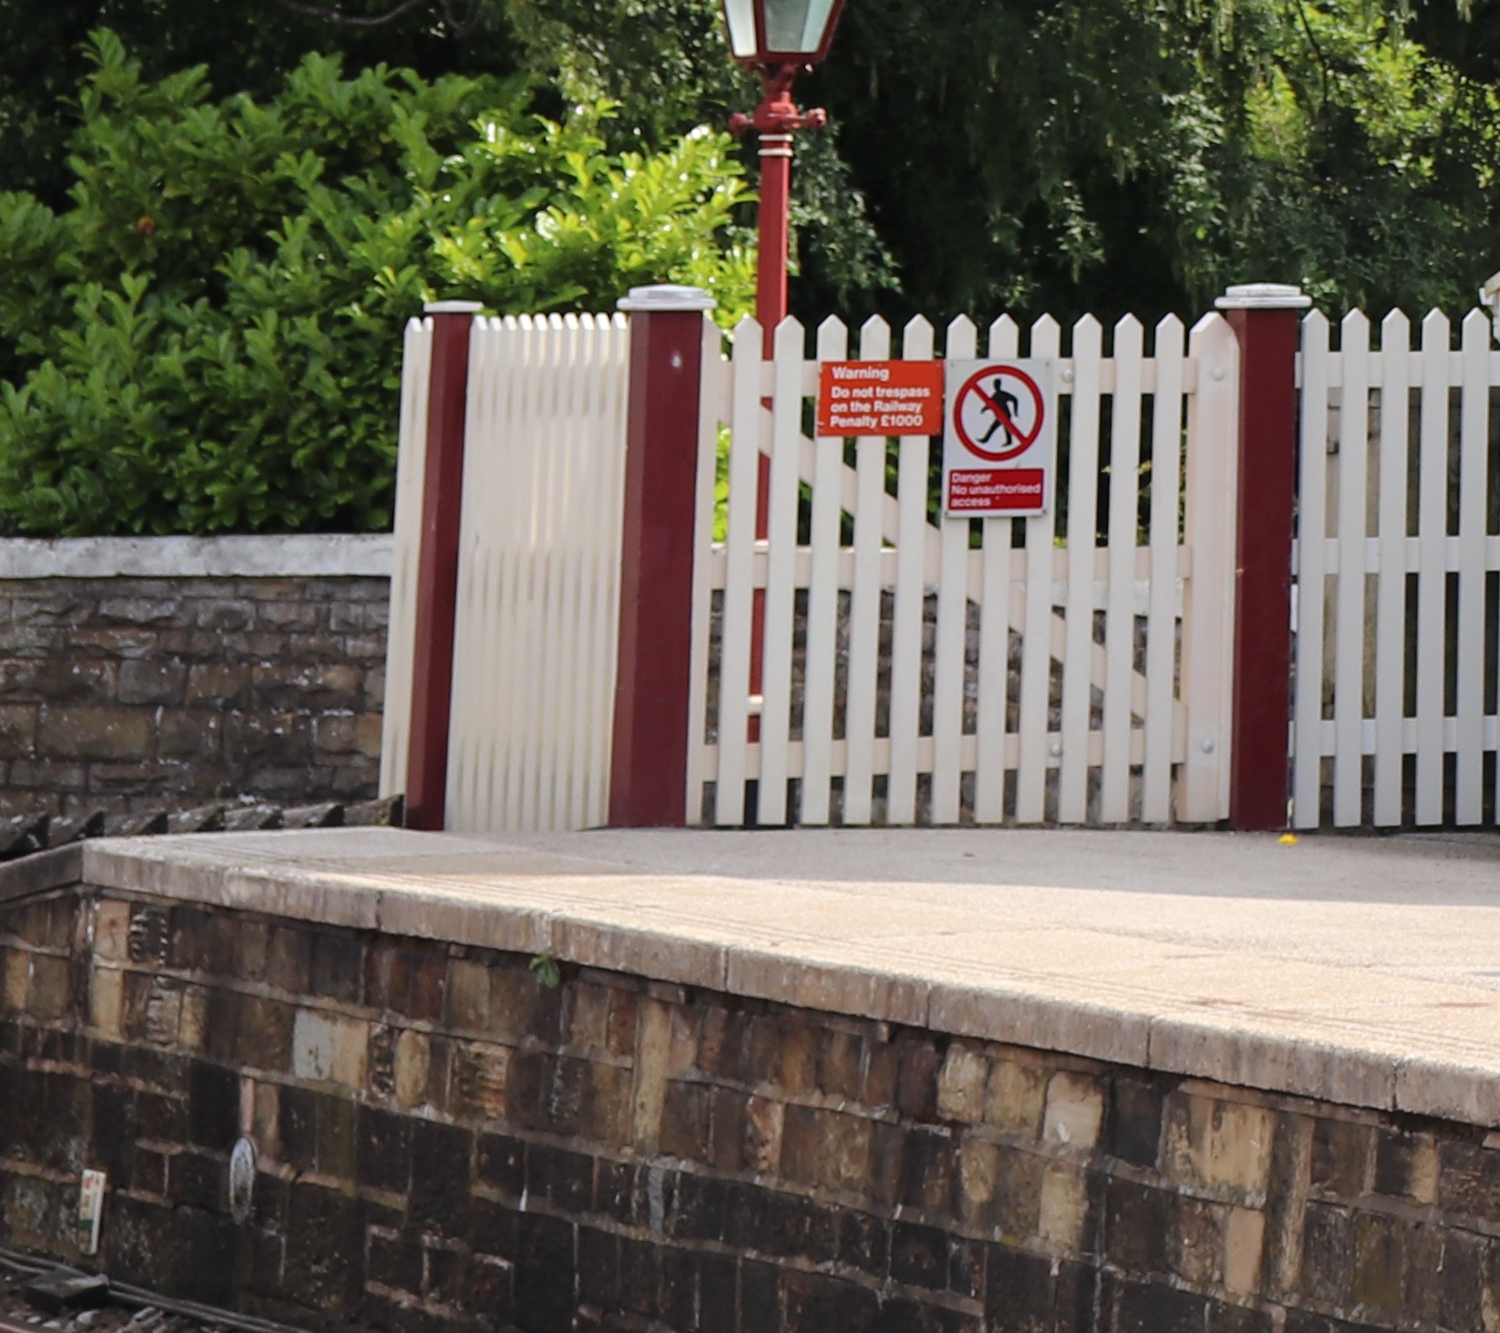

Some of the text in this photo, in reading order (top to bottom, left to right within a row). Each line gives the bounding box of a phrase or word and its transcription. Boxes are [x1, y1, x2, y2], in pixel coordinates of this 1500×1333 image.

[832, 366, 890, 382] Warning
[831, 386, 931, 400] Do not trespass
[830, 400, 923, 414] on the Railway
[830, 414, 924, 429] Penalty £1000
[951, 473, 992, 485] Danger
[951, 485, 968, 495] No
[951, 498, 991, 507] access
